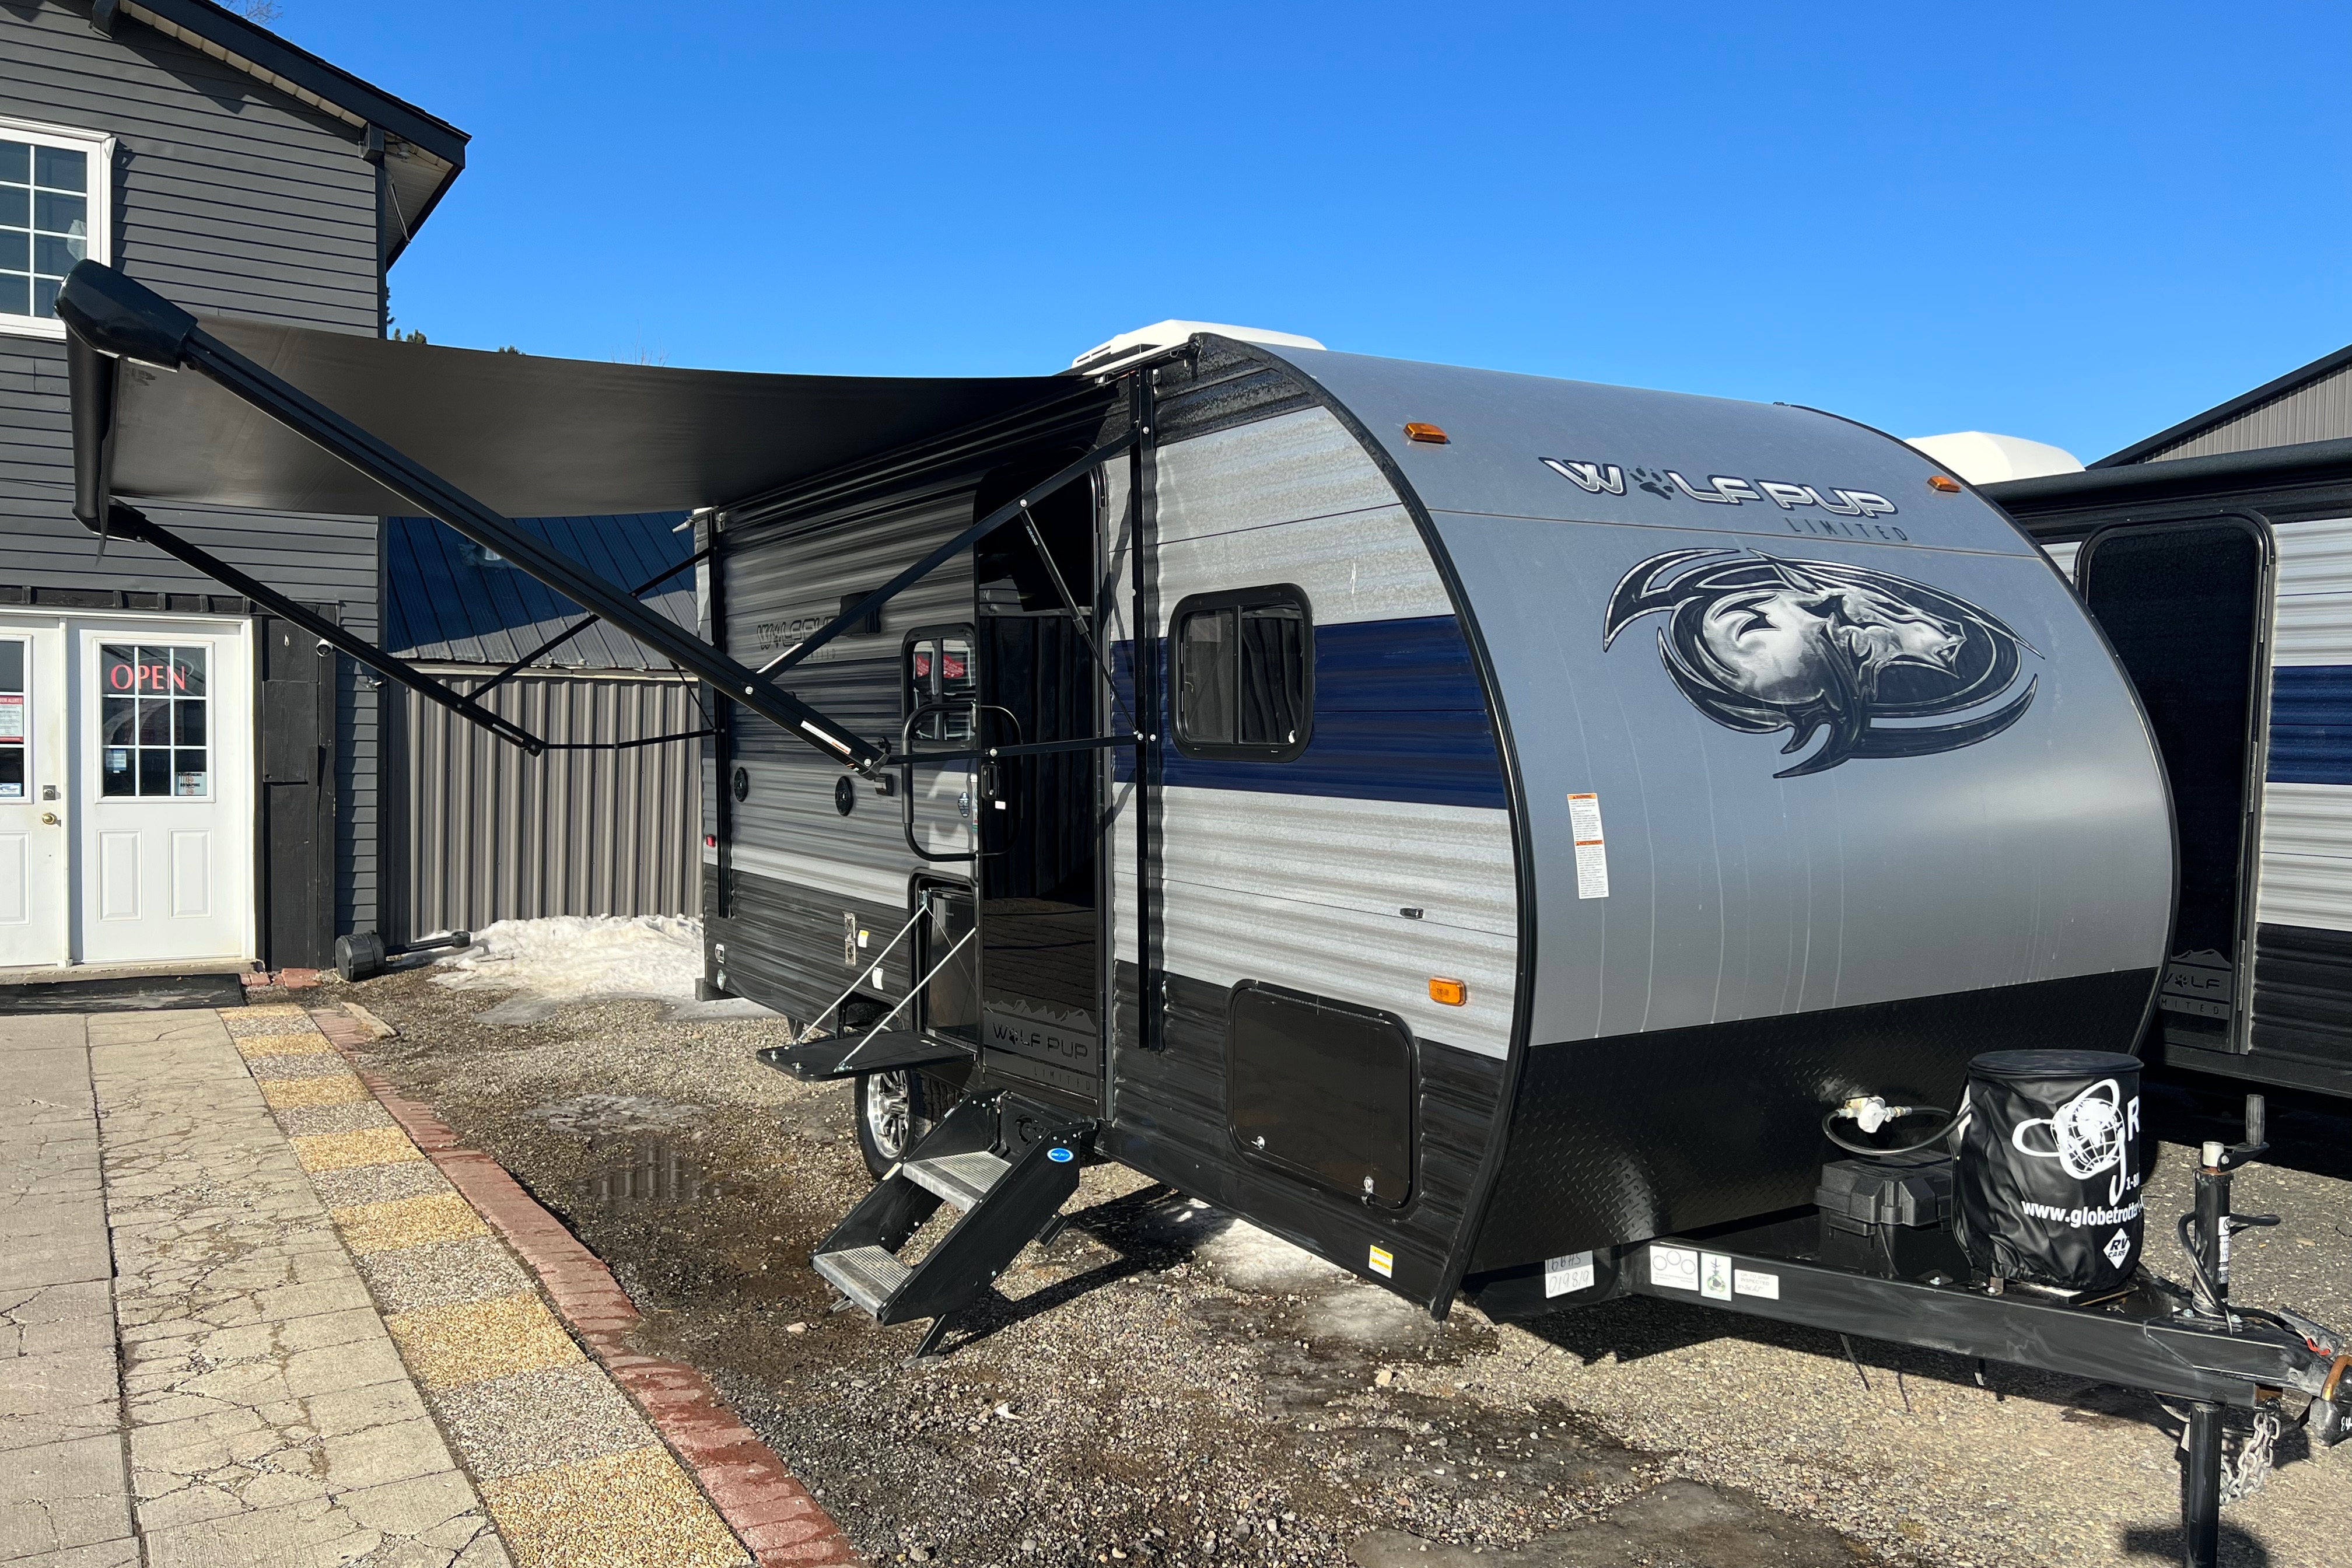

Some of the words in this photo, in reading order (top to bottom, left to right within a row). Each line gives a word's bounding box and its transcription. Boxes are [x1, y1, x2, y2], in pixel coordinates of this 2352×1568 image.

[1754, 479, 1899, 519] PUP
[1783, 517, 1908, 541] LIMITED
[110, 664, 186, 690] OPEN
[2161, 998, 2220, 1014] MITED
[1047, 1035, 1088, 1059] PUP
[1034, 1066, 1090, 1090] LIMITED
[2127, 1095, 2140, 1142] R
[2108, 1249, 2126, 1258] CARE
[2109, 1236, 2129, 1251] RV
